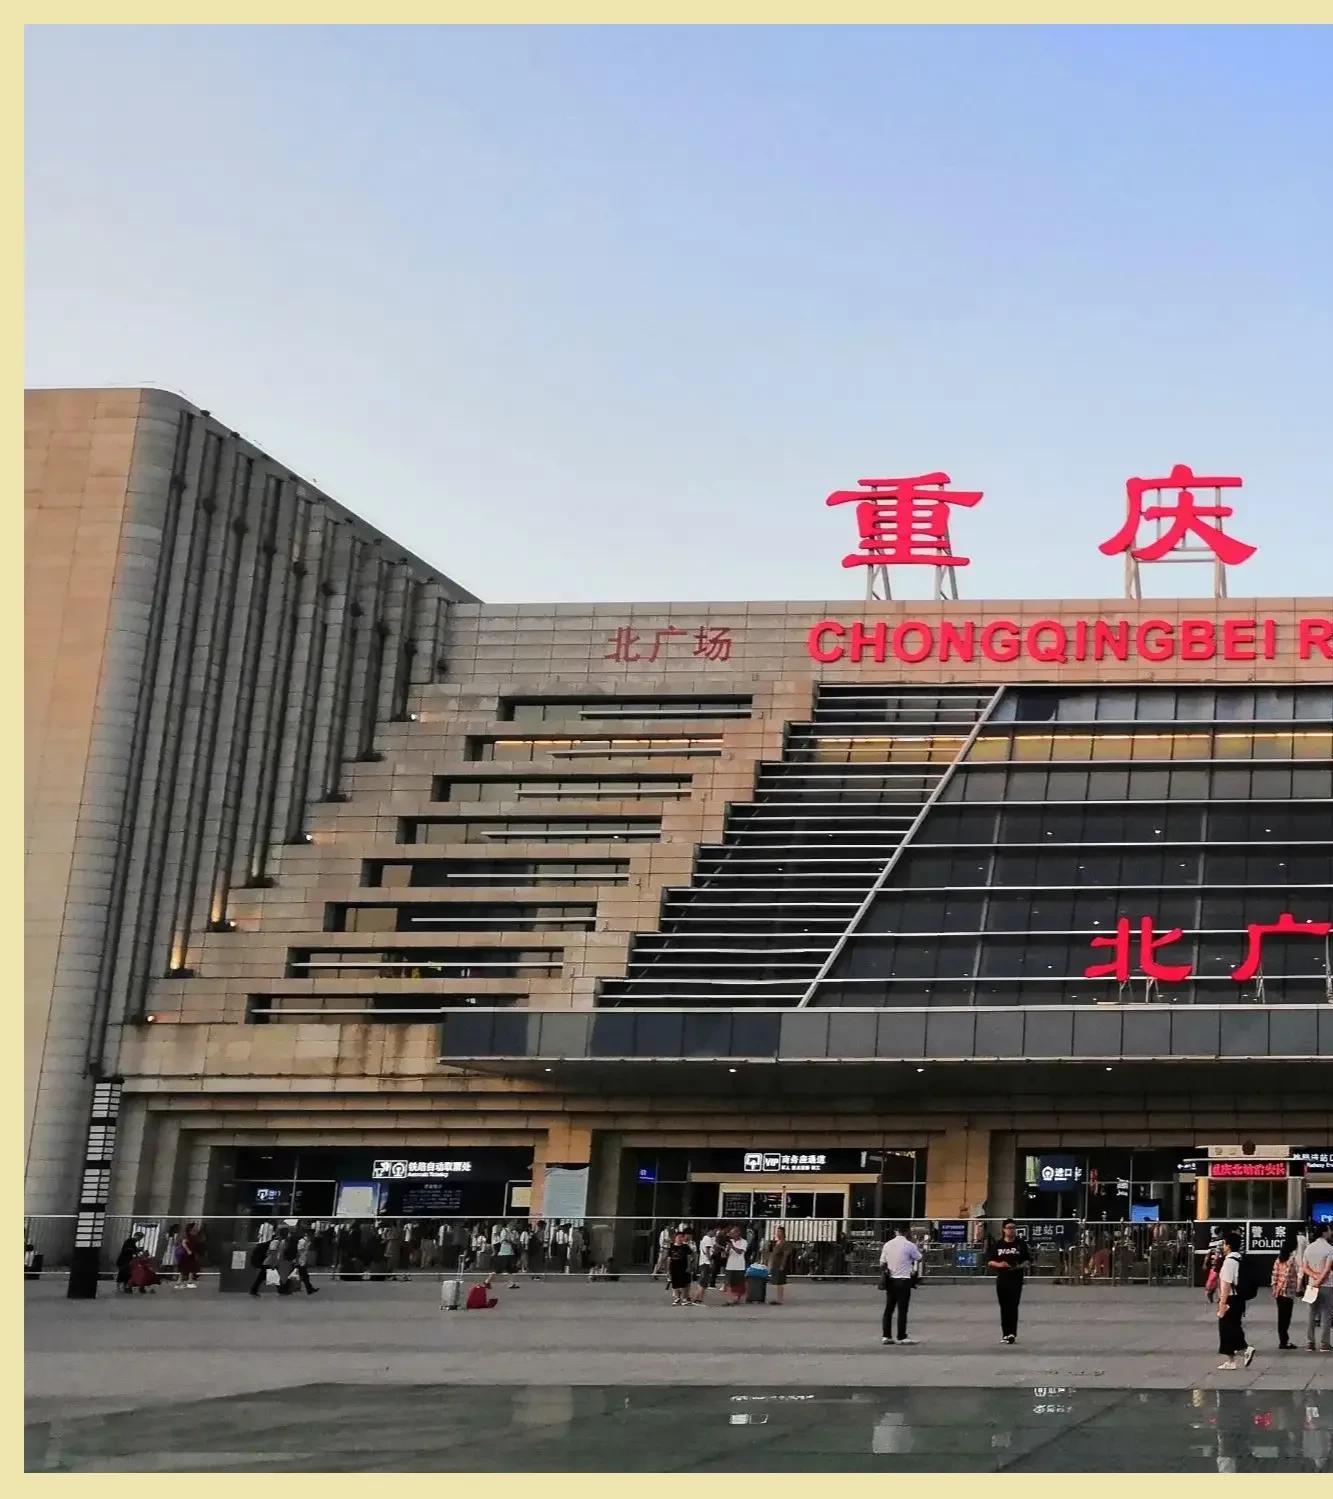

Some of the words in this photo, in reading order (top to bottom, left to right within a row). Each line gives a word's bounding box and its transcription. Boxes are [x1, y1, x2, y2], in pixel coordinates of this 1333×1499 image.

[605, 625, 733, 662] 北广场
[806, 617, 1277, 665] CHONGQINGBEI
[765, 1157, 779, 1167] VIP
[1032, 1224, 1064, 1236] 进站口
[1251, 1226, 1287, 1238] 警察
